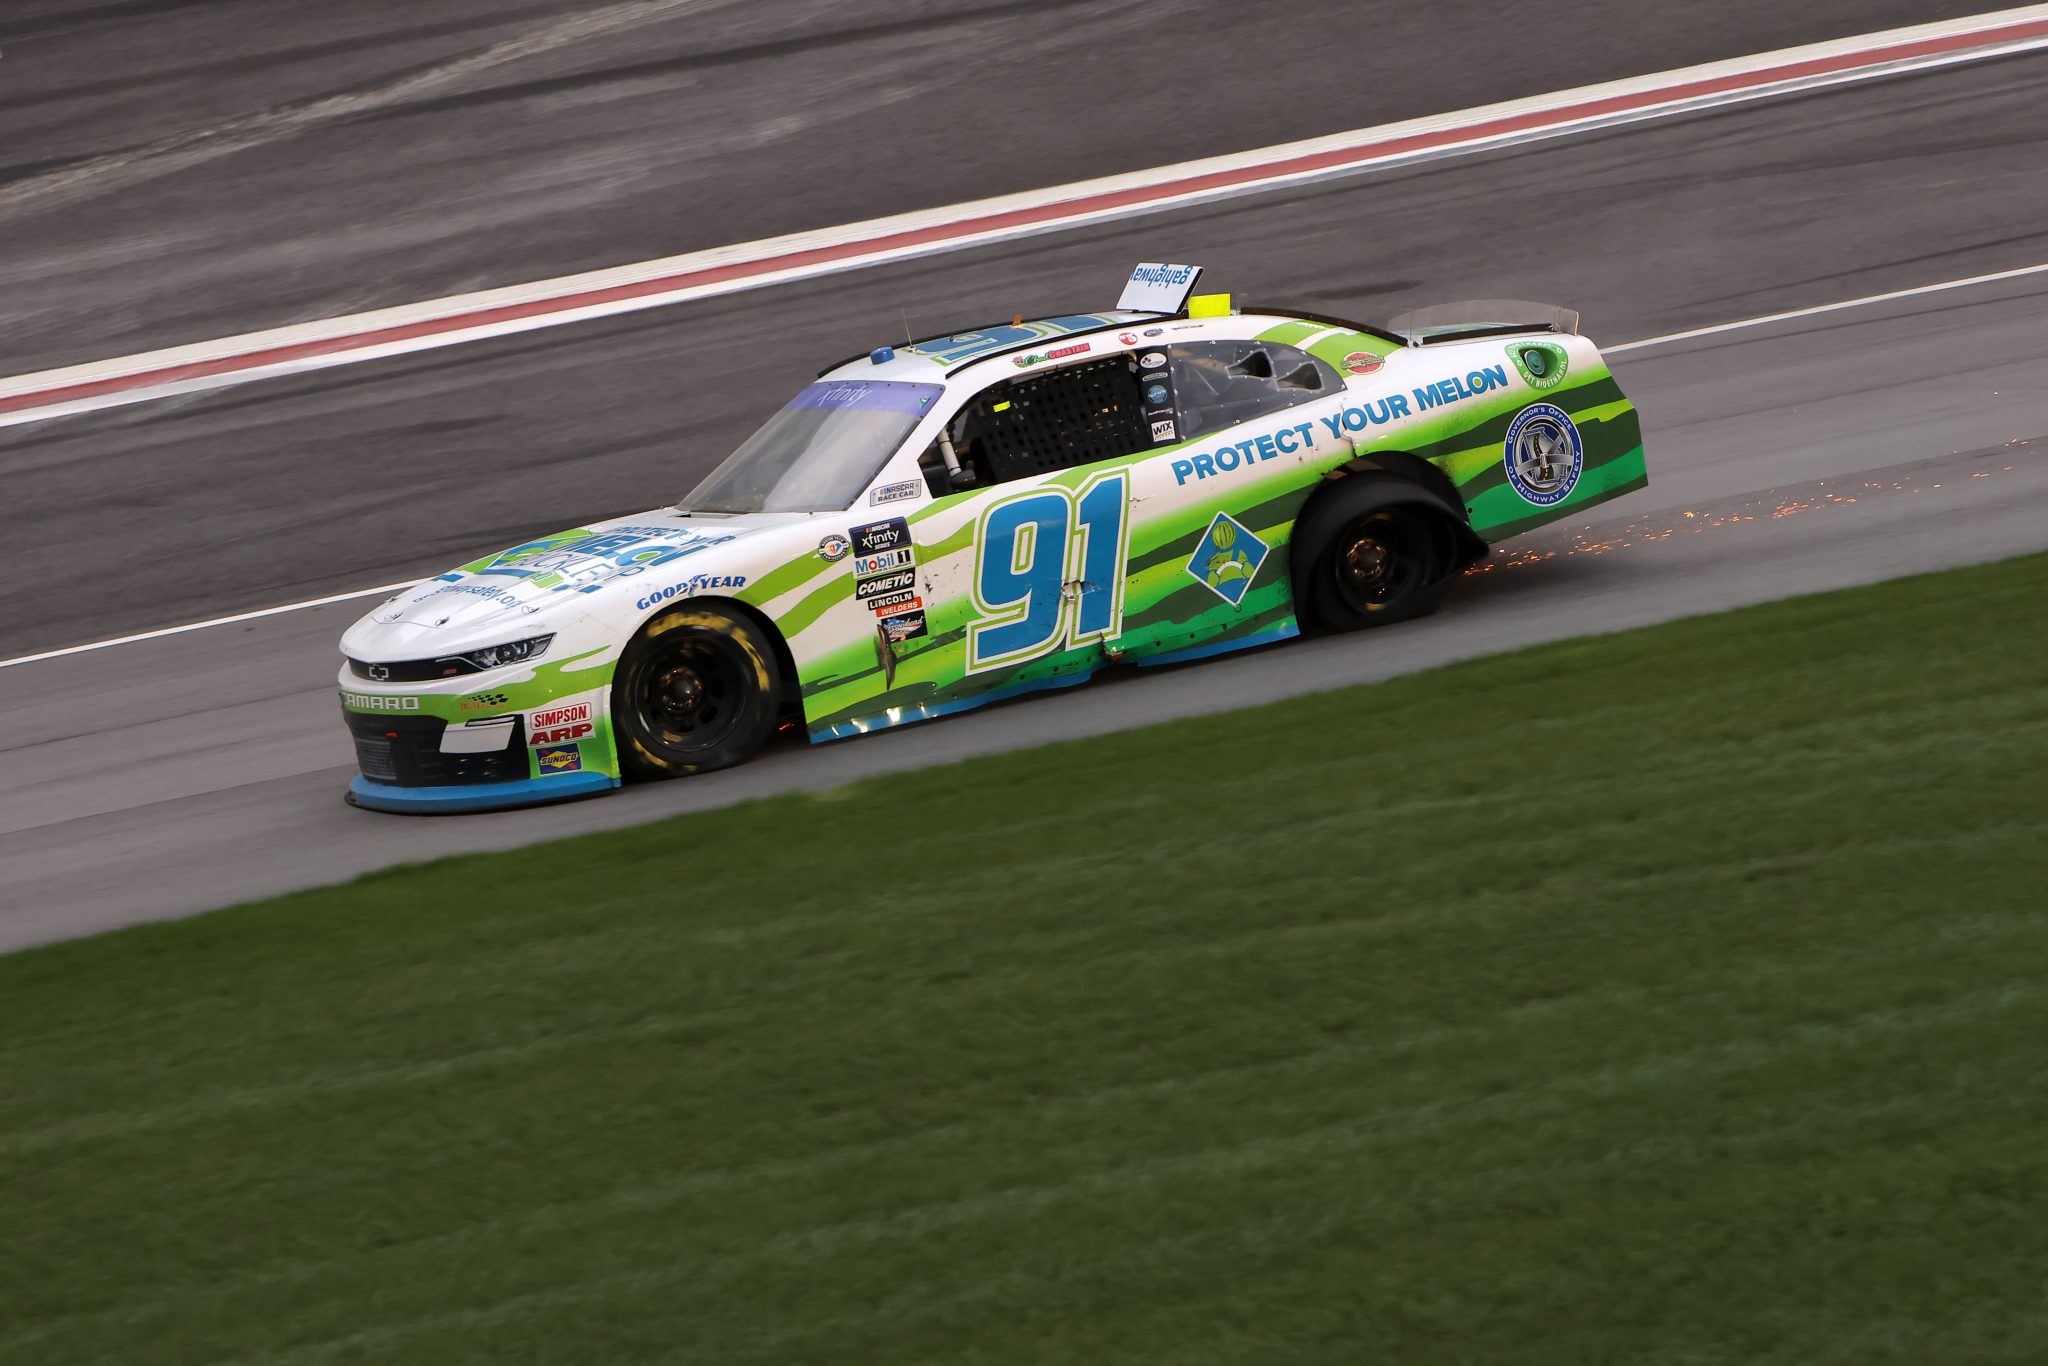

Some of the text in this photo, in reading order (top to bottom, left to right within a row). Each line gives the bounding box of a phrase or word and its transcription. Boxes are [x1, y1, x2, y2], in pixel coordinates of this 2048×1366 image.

[1048, 343, 1091, 359] CHASTAIN
[1523, 359, 1567, 388] GET BIOETHANOL
[817, 384, 873, 407] xfinity
[1153, 421, 1172, 435] WIX
[1171, 365, 1509, 486] PROTECT YOUR MELON
[1507, 406, 1573, 444] GOVERNOR'S OFFICE
[1517, 483, 1560, 502] HIGHWAY
[1563, 451, 1580, 492] SAFETY
[877, 489, 914, 502] RACE CAR
[882, 482, 914, 495] NASCAR
[861, 530, 899, 548] xfinity
[855, 553, 894, 574] Mobil
[968, 469, 1129, 672] 91
[635, 574, 746, 611] GOODYEAR
[858, 571, 913, 595] COMETIC
[881, 601, 918, 616] WELDERS
[534, 705, 587, 728] SIMPSON
[529, 723, 593, 745] ARP
[541, 753, 579, 766] SUNOCO
